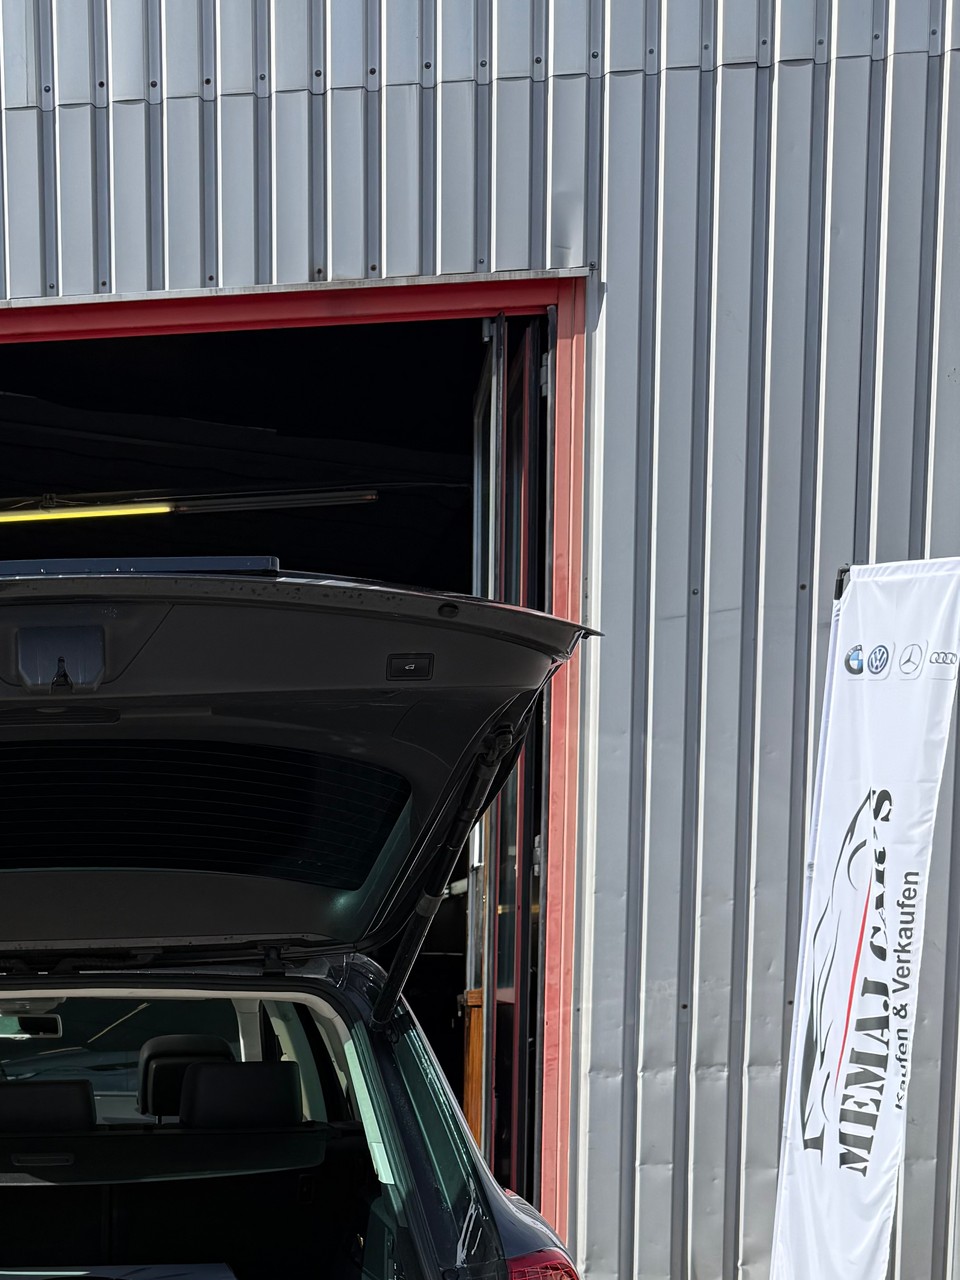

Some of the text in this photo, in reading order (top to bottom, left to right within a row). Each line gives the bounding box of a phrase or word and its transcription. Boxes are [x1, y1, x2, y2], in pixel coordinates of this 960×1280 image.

[892, 871, 920, 994] Verkaufen
[893, 1003, 908, 1019] &
[839, 976, 891, 1178] MEMAJ
